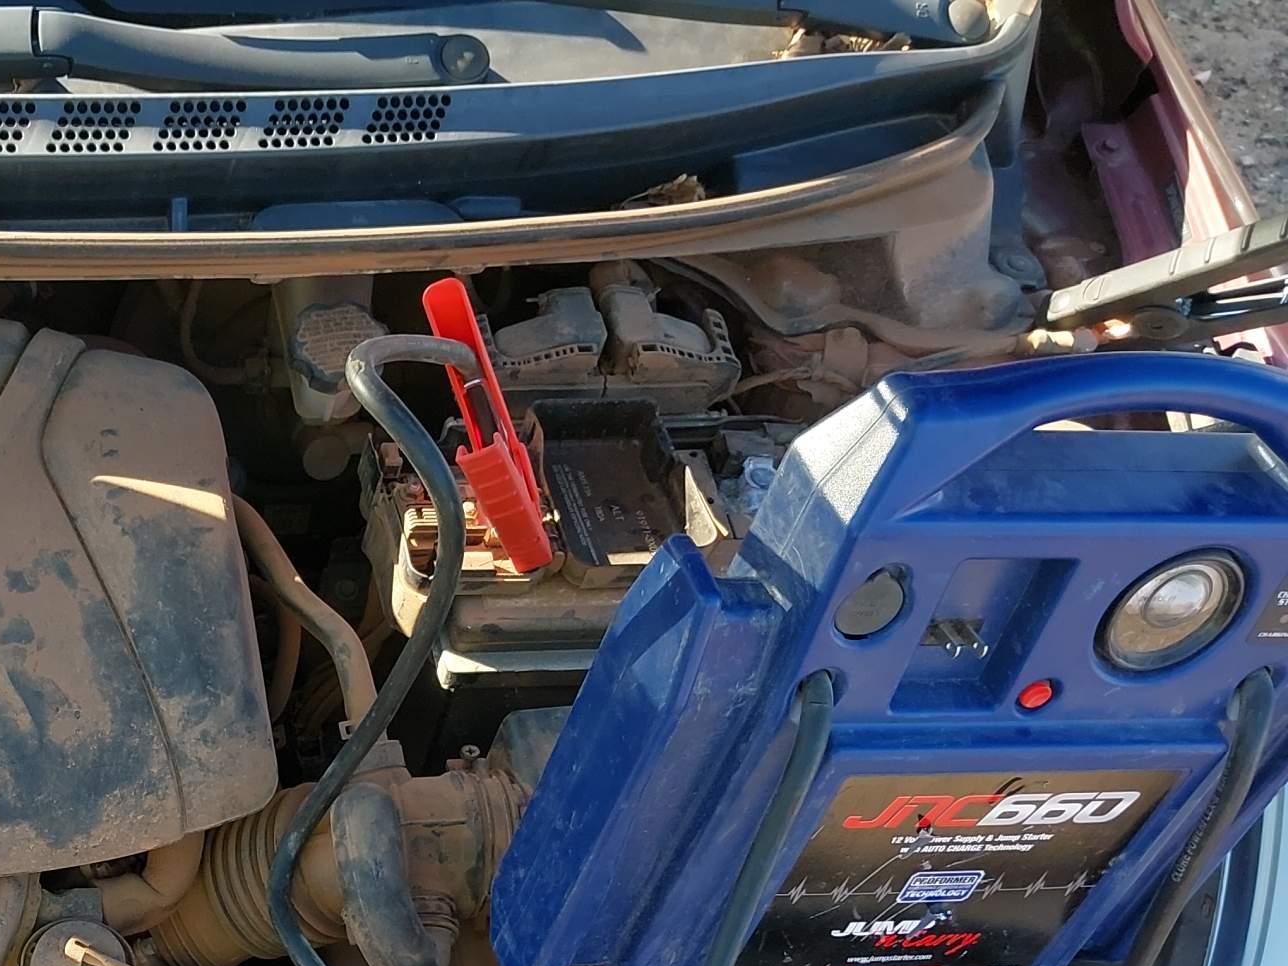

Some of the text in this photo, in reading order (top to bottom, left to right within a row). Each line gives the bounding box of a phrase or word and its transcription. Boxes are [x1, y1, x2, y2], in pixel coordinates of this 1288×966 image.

[842, 791, 1141, 829] JNC660
[891, 836, 903, 844] 12
[953, 834, 985, 845] Supply
[985, 834, 994, 842] &
[994, 834, 1022, 844] Jump
[1023, 832, 1055, 842] Starter
[920, 845, 946, 854] AUTO
[946, 844, 984, 853] CHARGE
[983, 842, 1034, 853] Technology
[904, 889, 968, 898] TECHNOLOGY
